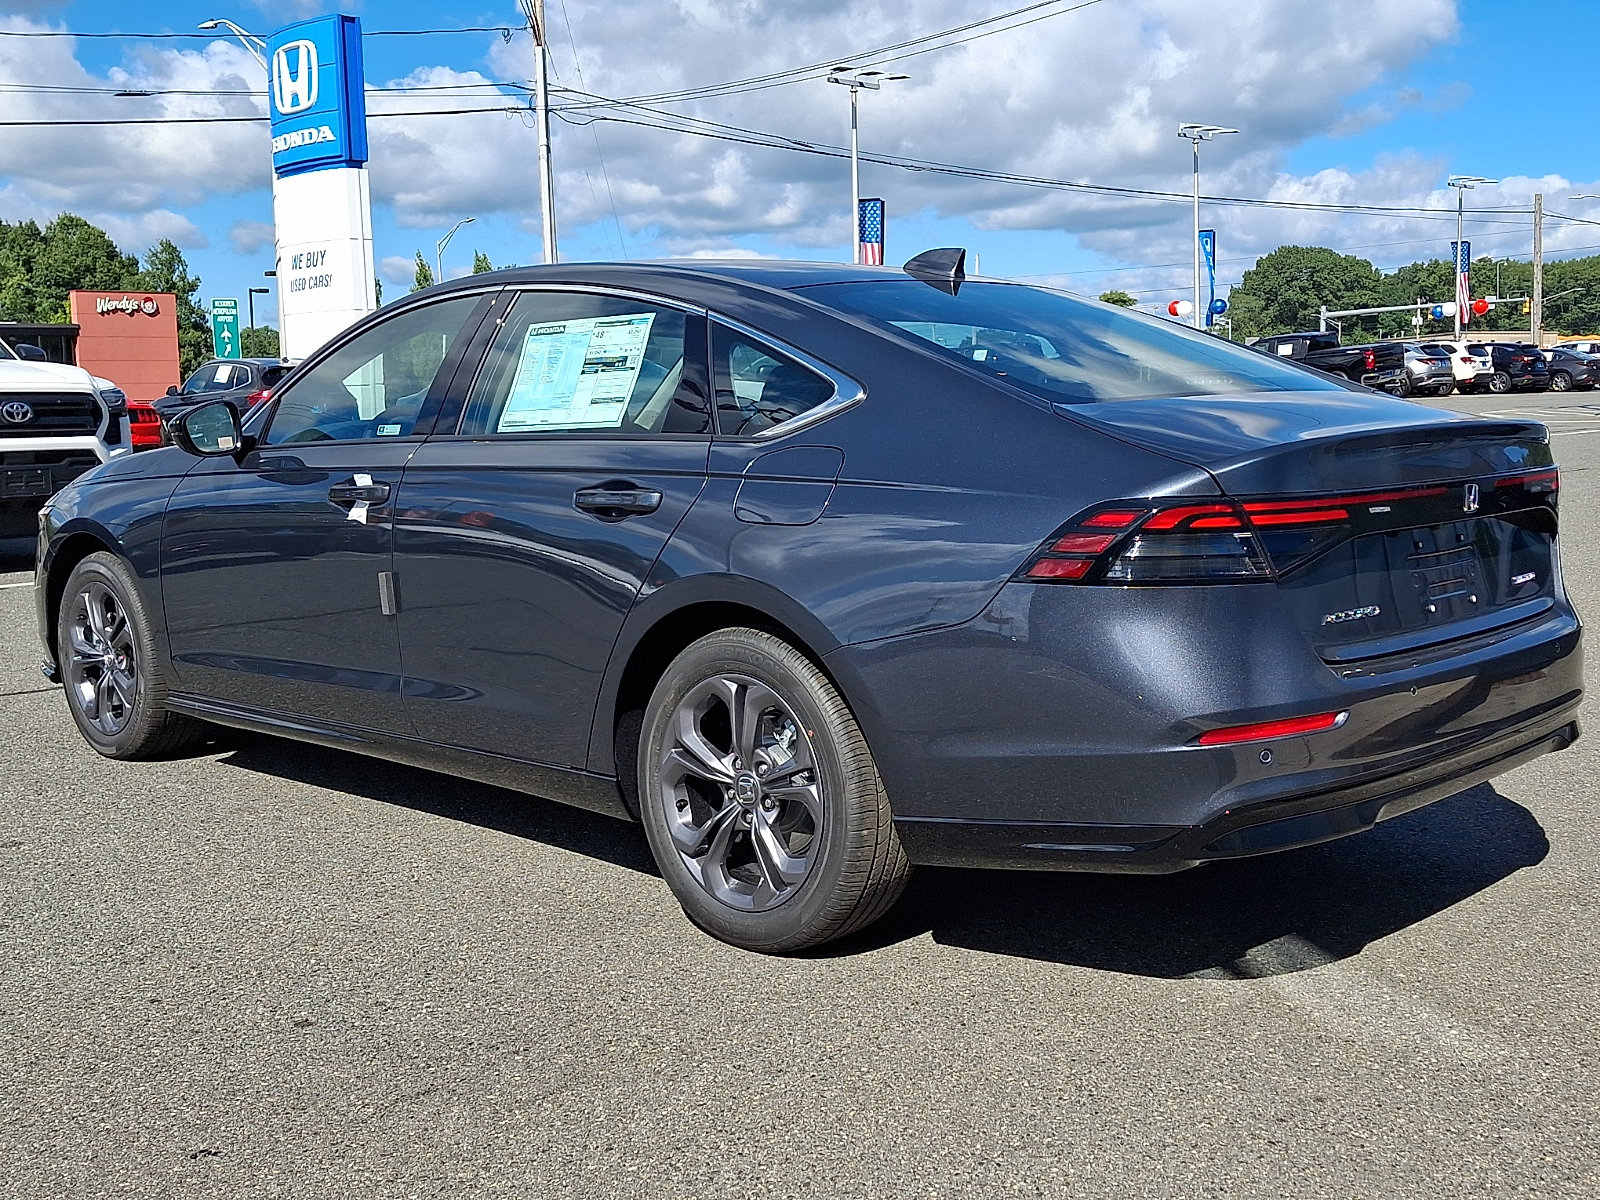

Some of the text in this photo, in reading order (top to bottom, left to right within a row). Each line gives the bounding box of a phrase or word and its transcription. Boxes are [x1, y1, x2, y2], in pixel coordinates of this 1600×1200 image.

[271, 126, 336, 153] HONDA
[292, 250, 327, 270] WE BUY
[291, 274, 332, 292] USED CARS!
[96, 295, 139, 313] Wendy's
[538, 326, 565, 334] HONDA
